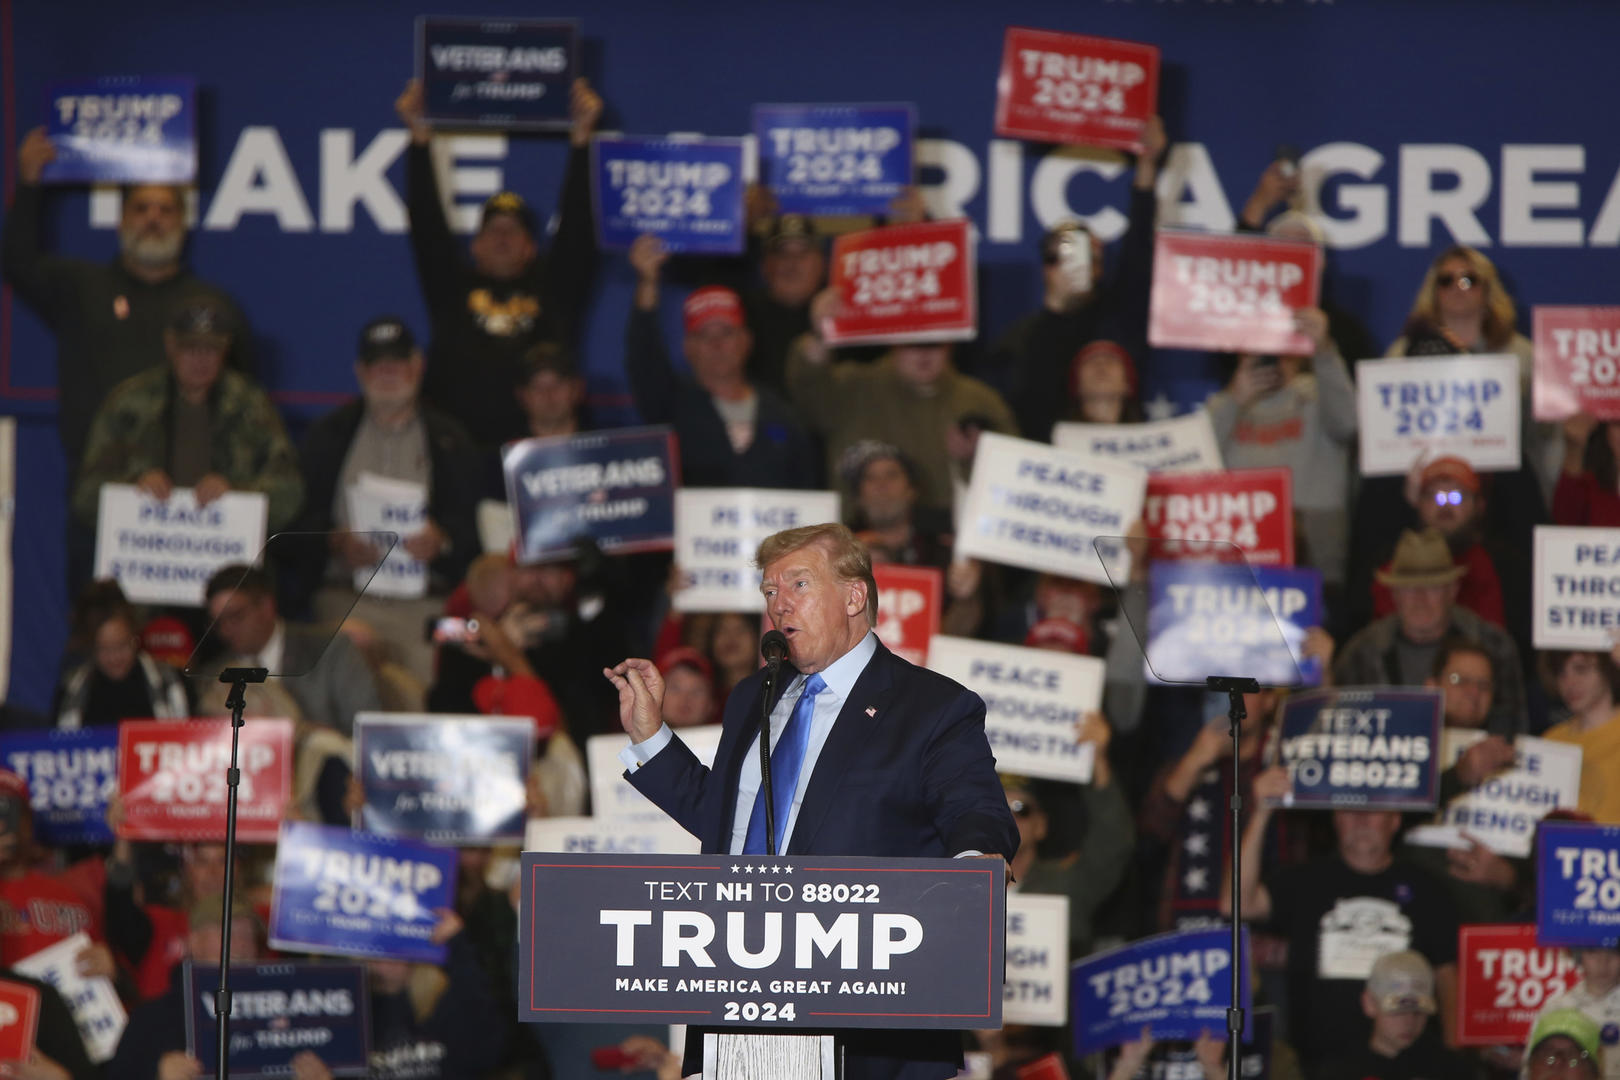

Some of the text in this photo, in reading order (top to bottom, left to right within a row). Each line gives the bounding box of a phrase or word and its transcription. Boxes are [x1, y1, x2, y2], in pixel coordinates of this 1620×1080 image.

[430, 45, 567, 73] VETERANS
[1018, 48, 1148, 88] TRUMP
[54, 93, 184, 124] TRUMP
[1031, 76, 1127, 114] 2024
[768, 126, 901, 157] TRUMP
[88, 125, 508, 234] AKE
[605, 159, 732, 189] TRUMP
[786, 153, 884, 187] 2024
[620, 186, 714, 218] 2024
[842, 240, 957, 277] TRUMP
[1173, 254, 1303, 289] TRUMP
[852, 265, 942, 305] 2024
[1188, 283, 1286, 316] 2024
[1376, 379, 1502, 409] TRUMP
[1395, 409, 1484, 436] 2024
[1091, 432, 1175, 456] PEACE
[522, 456, 666, 499] VETERANS
[1017, 457, 1108, 494] PEACE
[138, 502, 225, 526] PEACE
[1146, 490, 1277, 527] TRUMP
[1160, 522, 1259, 553] 2024
[1166, 582, 1309, 617] TRUMP
[970, 657, 1062, 692] PEACE
[1319, 707, 1392, 733] TEXT
[133, 741, 276, 776] TRUMP
[1280, 733, 1432, 764] VETERANS
[304, 847, 443, 892] TRUMP
[313, 882, 420, 922] 2024
[644, 881, 880, 904] TEXT NH TO 88022
[600, 909, 924, 970] TRUMP
[615, 978, 906, 996] MAKE AMERICA GREAT AGAIN!
[1088, 948, 1232, 1000] TRUMP
[723, 1002, 796, 1022] 2024
[1107, 977, 1213, 1018] 2024
